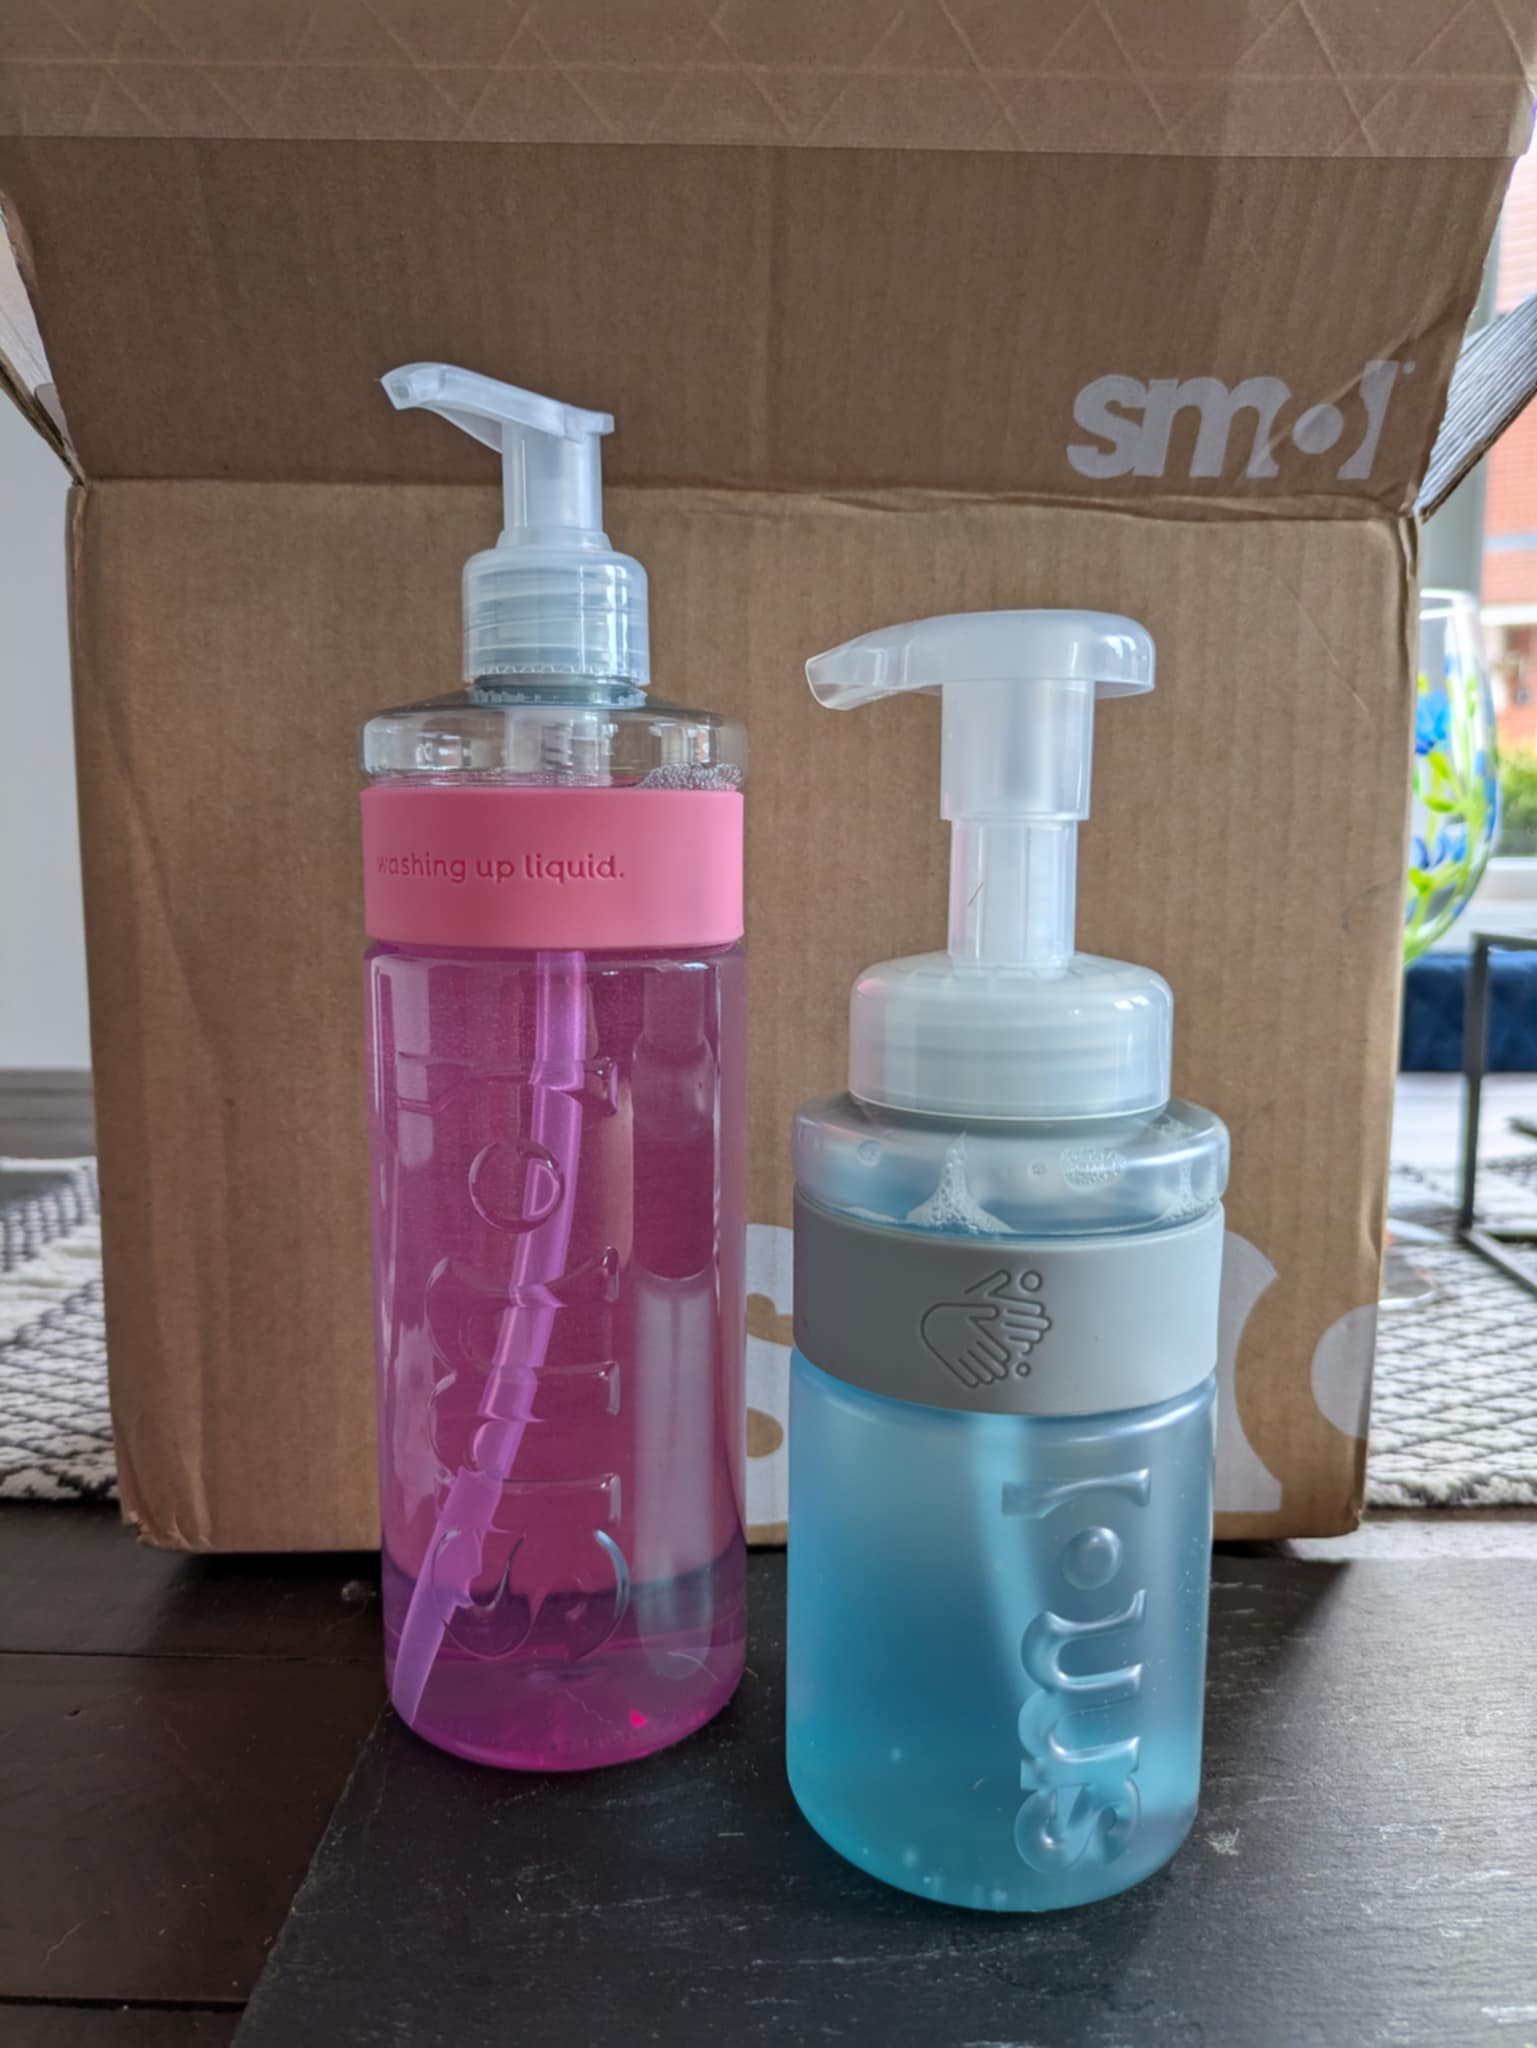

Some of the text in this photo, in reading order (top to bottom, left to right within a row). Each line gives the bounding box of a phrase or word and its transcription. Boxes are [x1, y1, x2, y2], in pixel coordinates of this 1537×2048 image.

[1066, 359, 1399, 480] smol
[376, 852, 625, 884] washing up liquid.
[1001, 1468, 1151, 1875] smol
